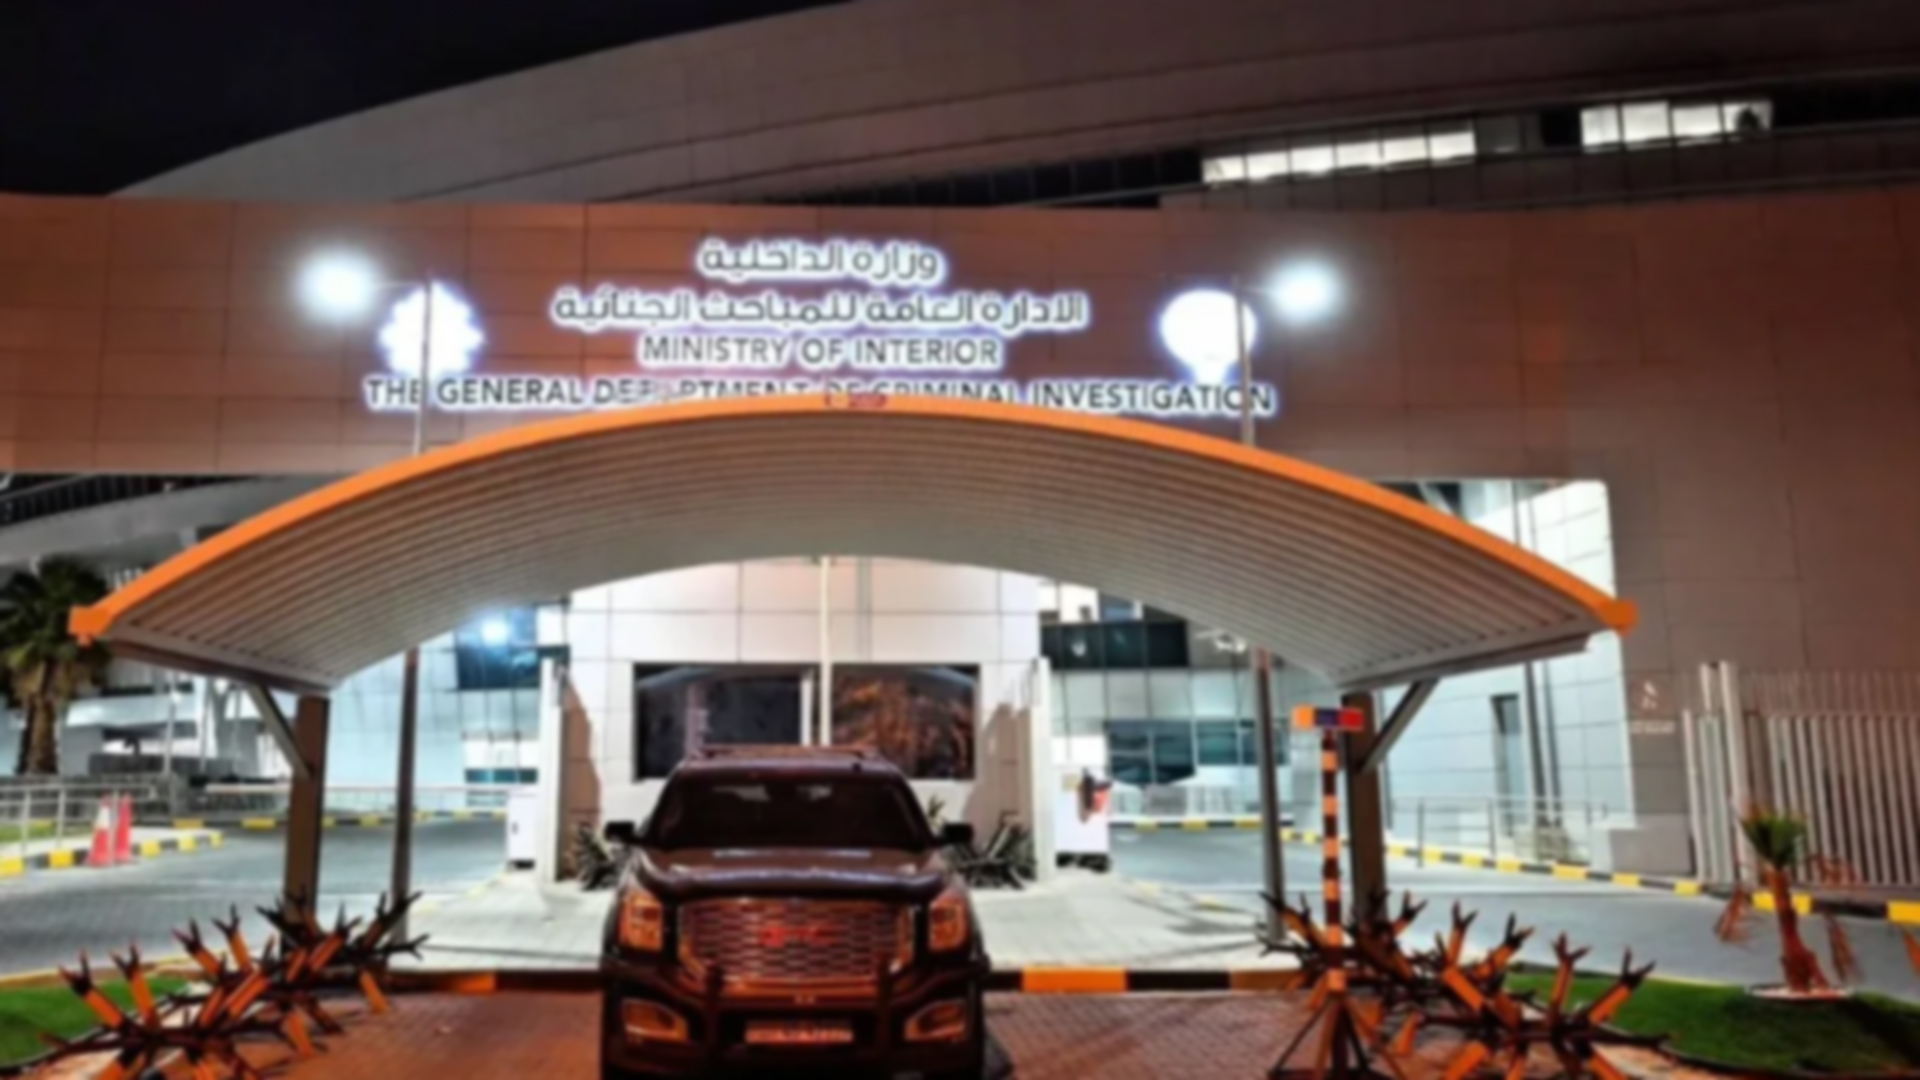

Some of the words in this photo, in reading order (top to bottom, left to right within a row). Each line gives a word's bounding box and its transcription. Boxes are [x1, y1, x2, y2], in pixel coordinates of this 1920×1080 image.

[702, 241, 845, 278] الداخلية
[853, 243, 939, 279] وزارة
[555, 288, 692, 327] الجنائية
[700, 293, 857, 328] للمباحث
[866, 292, 974, 323] العامة
[643, 337, 789, 362] MINISTRY
[801, 338, 845, 364] OF
[855, 338, 999, 365] INTERIOR
[367, 379, 422, 404] THE
[436, 379, 583, 404] GENERAL
[1032, 383, 1274, 411] INVESTIGATION
